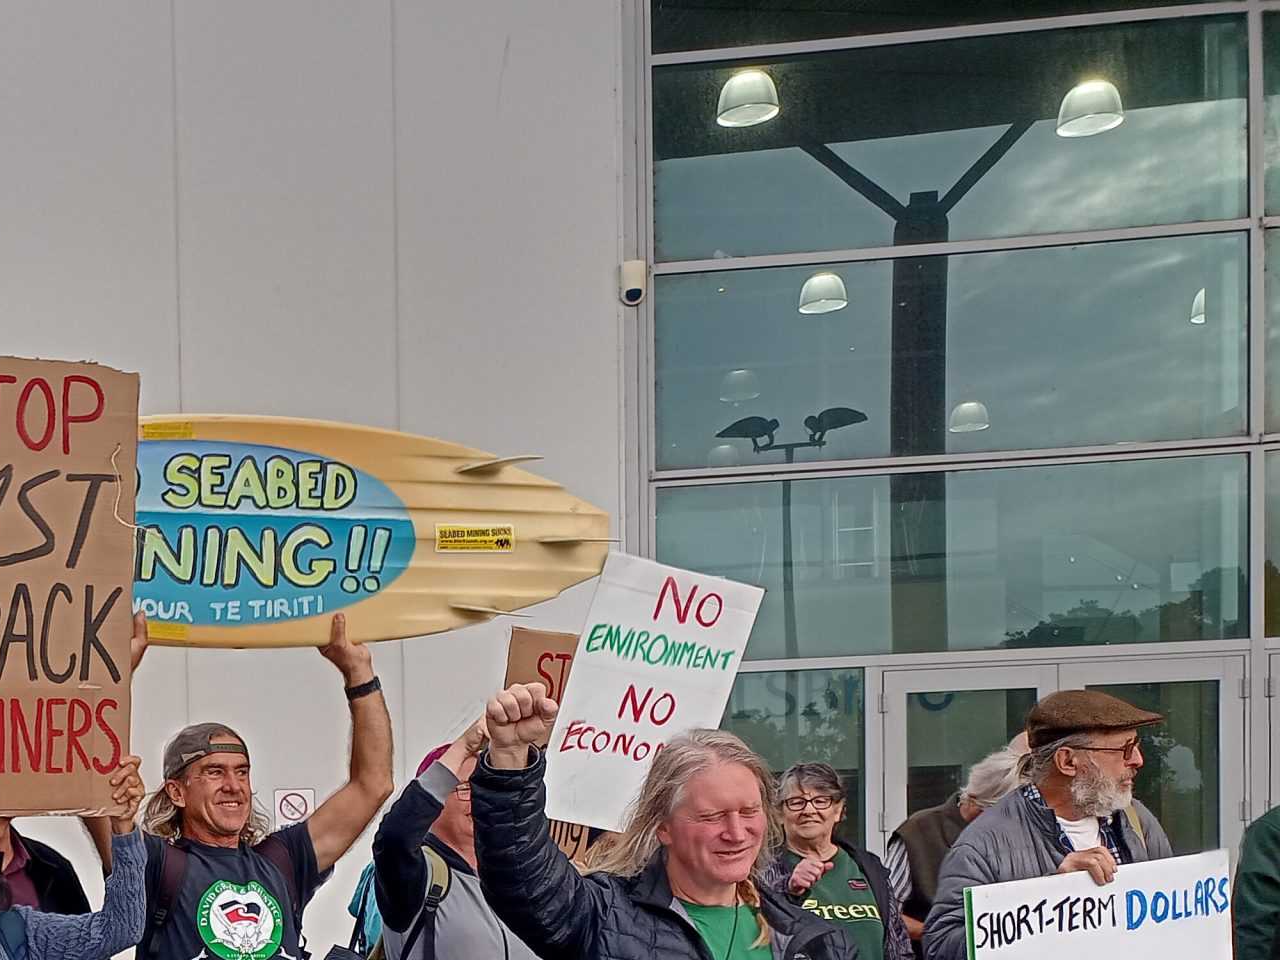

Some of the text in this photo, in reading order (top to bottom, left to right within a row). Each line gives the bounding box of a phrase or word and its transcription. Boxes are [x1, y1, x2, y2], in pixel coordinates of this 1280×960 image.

[162, 453, 358, 511] SEABED
[466, 529, 490, 538] MINING
[209, 600, 242, 622] TE
[248, 595, 323, 620] TIRITI
[653, 576, 723, 628] NO
[585, 624, 736, 671] ENVIRONMENT
[618, 684, 676, 727] NO
[976, 877, 1230, 949] SHORT-TERM DOLLARS
